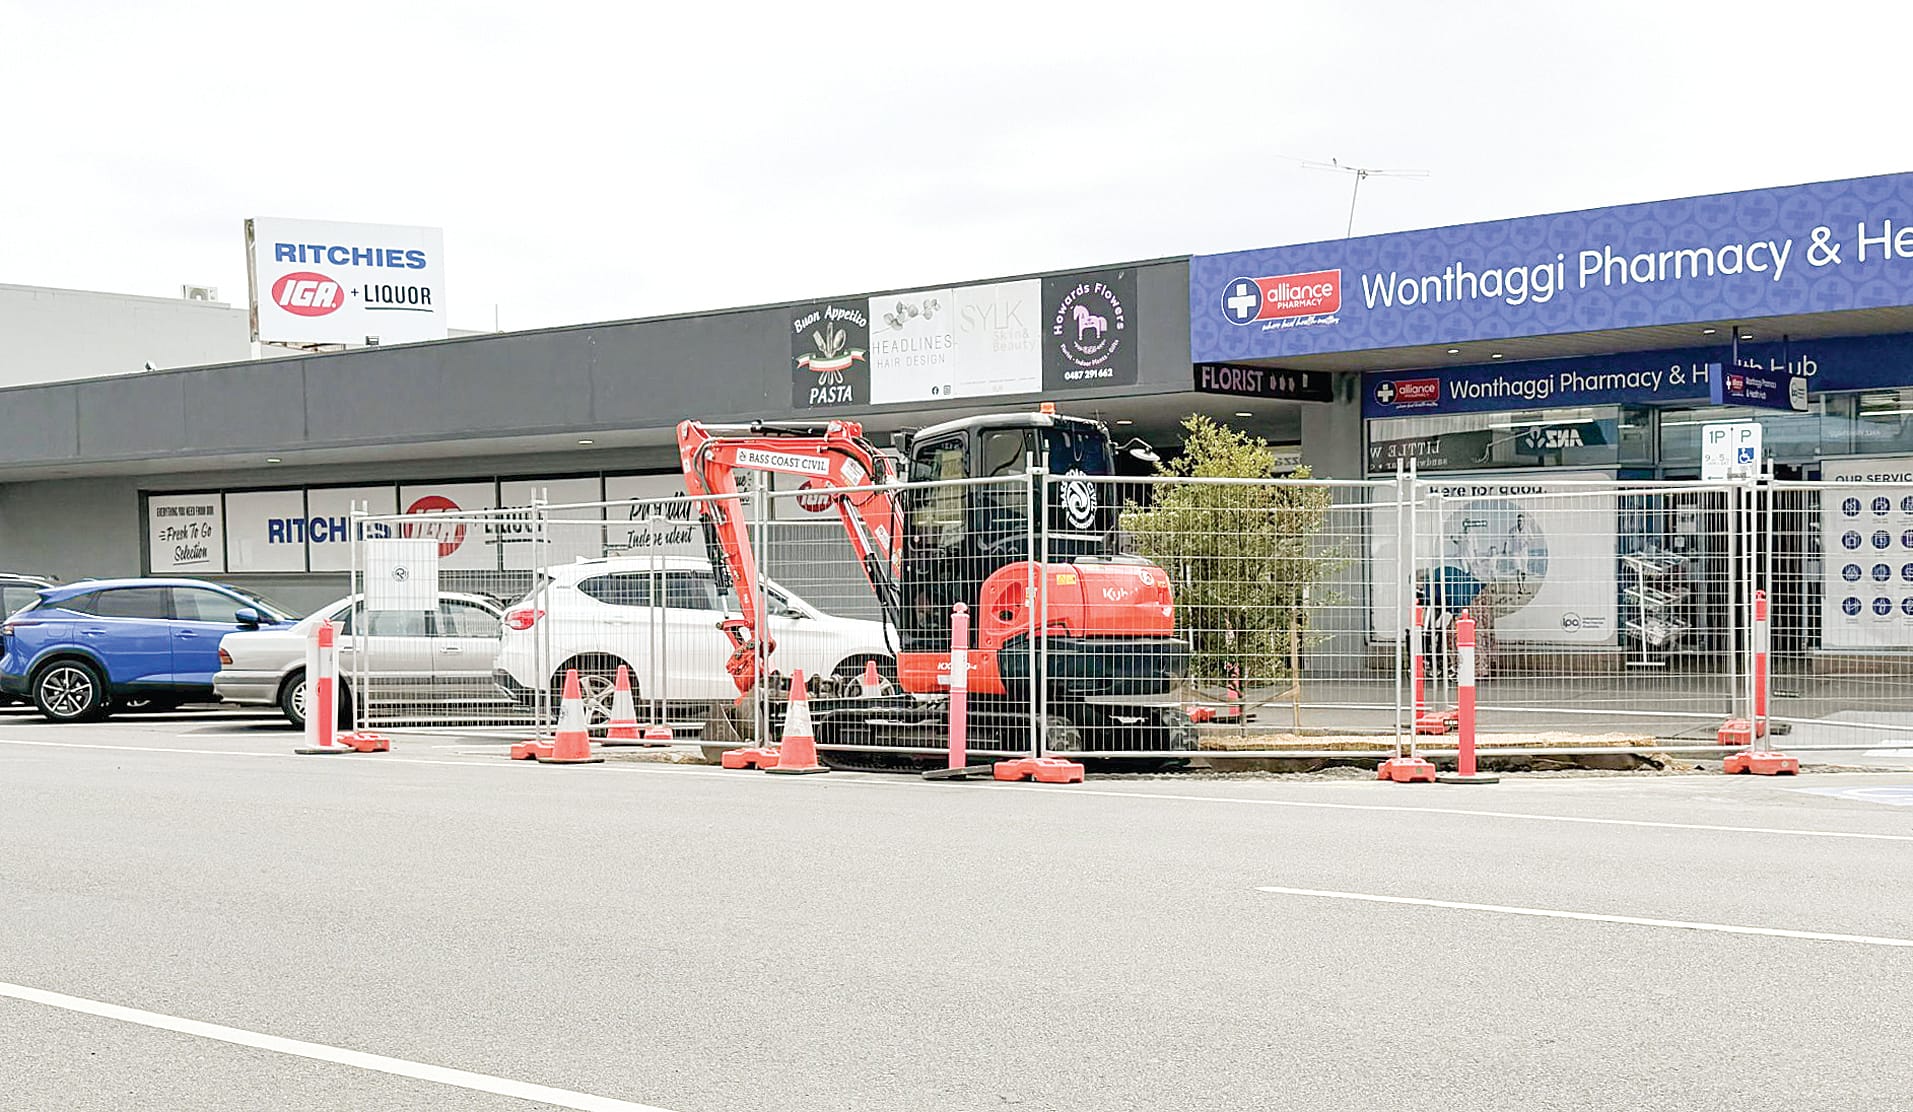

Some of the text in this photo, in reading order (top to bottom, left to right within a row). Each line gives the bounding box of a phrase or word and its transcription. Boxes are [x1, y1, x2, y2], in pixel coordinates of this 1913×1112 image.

[274, 242, 427, 270] RITCHIES
[1361, 252, 1565, 310] Wonthaggi
[1579, 238, 1793, 289] Pharmacy
[1806, 225, 1842, 268] &
[280, 279, 334, 308] IGA
[364, 284, 431, 305] LIQUOR
[1267, 283, 1333, 303] alliance
[1053, 282, 1124, 335] Howards Flowers
[1277, 298, 1323, 310] PHARMACY
[794, 304, 867, 333] Buon Appetito
[960, 300, 1024, 333] SYLK
[872, 334, 952, 355] HEADLINES
[877, 352, 945, 368] HAIR DESIGN
[1202, 366, 1264, 393] FLORIST
[1399, 384, 1436, 395] alliance
[1450, 374, 1554, 400] Wonthaggi
[1561, 371, 1663, 392] Pharmacy
[1669, 364, 1686, 385] &
[809, 385, 853, 404] PASTA
[1709, 430, 1726, 444] 1P
[1741, 429, 1752, 443] P
[749, 452, 827, 471] BASS COAST CIVIL
[167, 521, 213, 541] Fresh To Go
[174, 541, 208, 561] Selection
